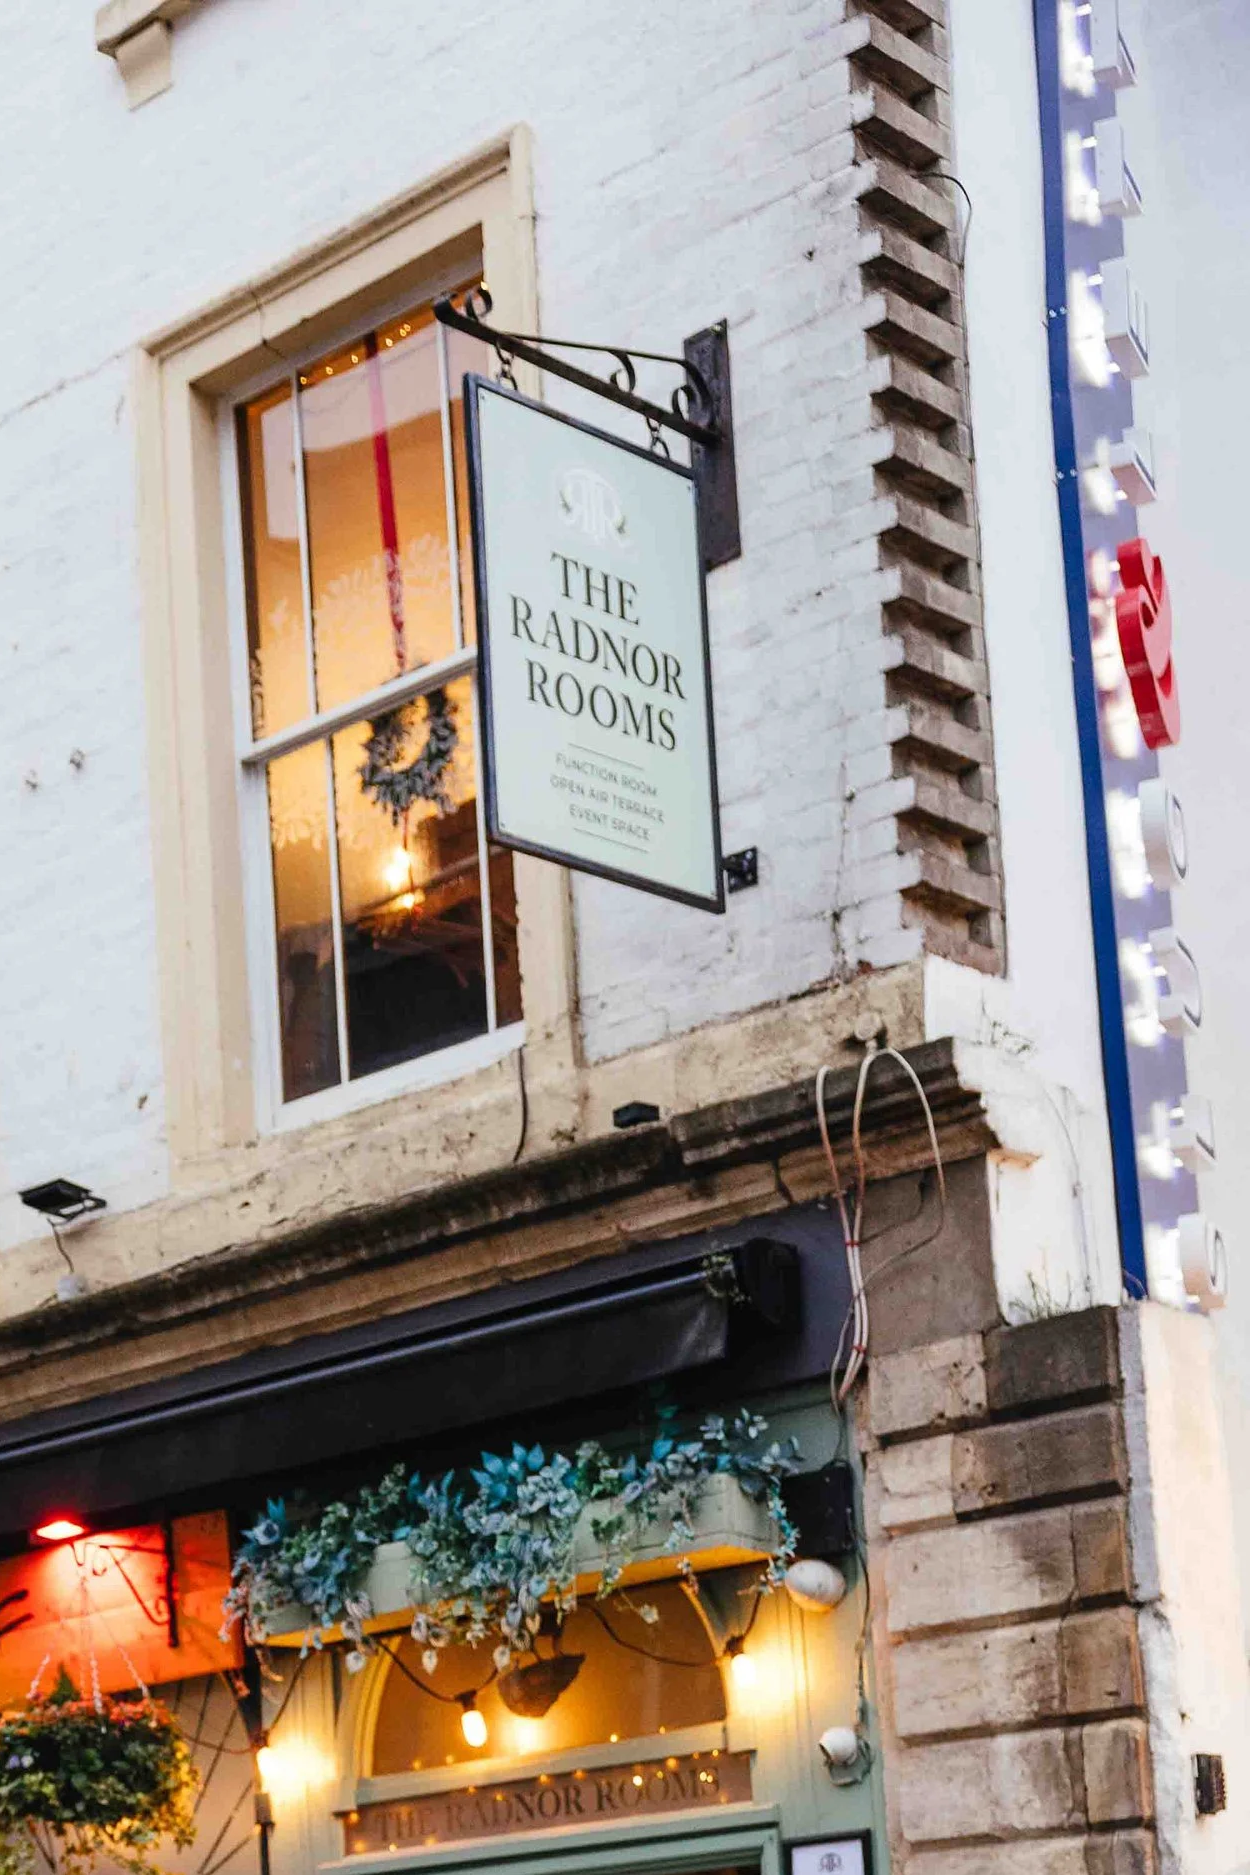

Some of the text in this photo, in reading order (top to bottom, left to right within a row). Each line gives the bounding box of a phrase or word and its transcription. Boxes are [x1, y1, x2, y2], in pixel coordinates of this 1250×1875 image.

[551, 551, 639, 626] THE
[509, 594, 687, 700] RADNOR
[525, 657, 678, 752] ROOMS
[550, 773, 585, 797] OPEN
[588, 786, 609, 803] AIR
[555, 751, 658, 797] FUNCTION ROOM
[569, 802, 651, 841] EVENT SPACE
[374, 1766, 721, 1842] THE RADNOR ROOMS
